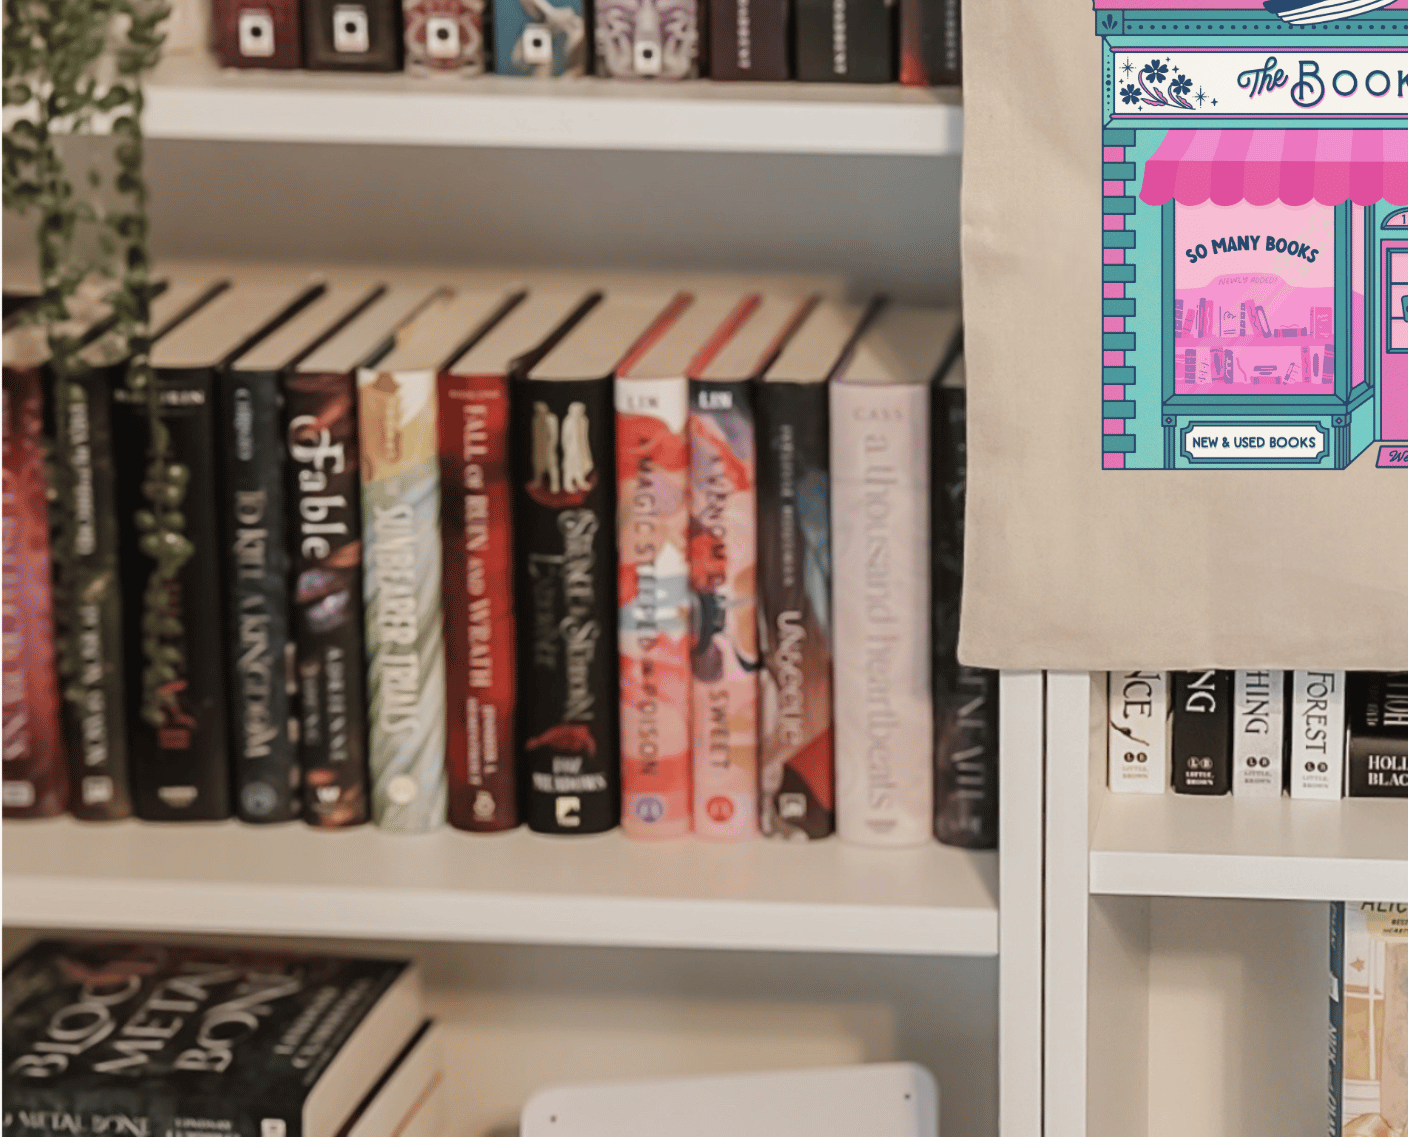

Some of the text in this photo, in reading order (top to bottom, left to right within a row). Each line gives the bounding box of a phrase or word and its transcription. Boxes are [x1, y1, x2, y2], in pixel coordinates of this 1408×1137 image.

[1237, 56, 1289, 99] The
[1185, 235, 1320, 264] SO MANY BOOKS
[1192, 436, 1316, 449] NEW & USED BOOKS
[287, 413, 347, 560] Fable
[864, 464, 899, 624] thousand
[708, 689, 731, 770] SWEET
[865, 634, 900, 810] heartbeats
[1304, 671, 1335, 755] FOREST
